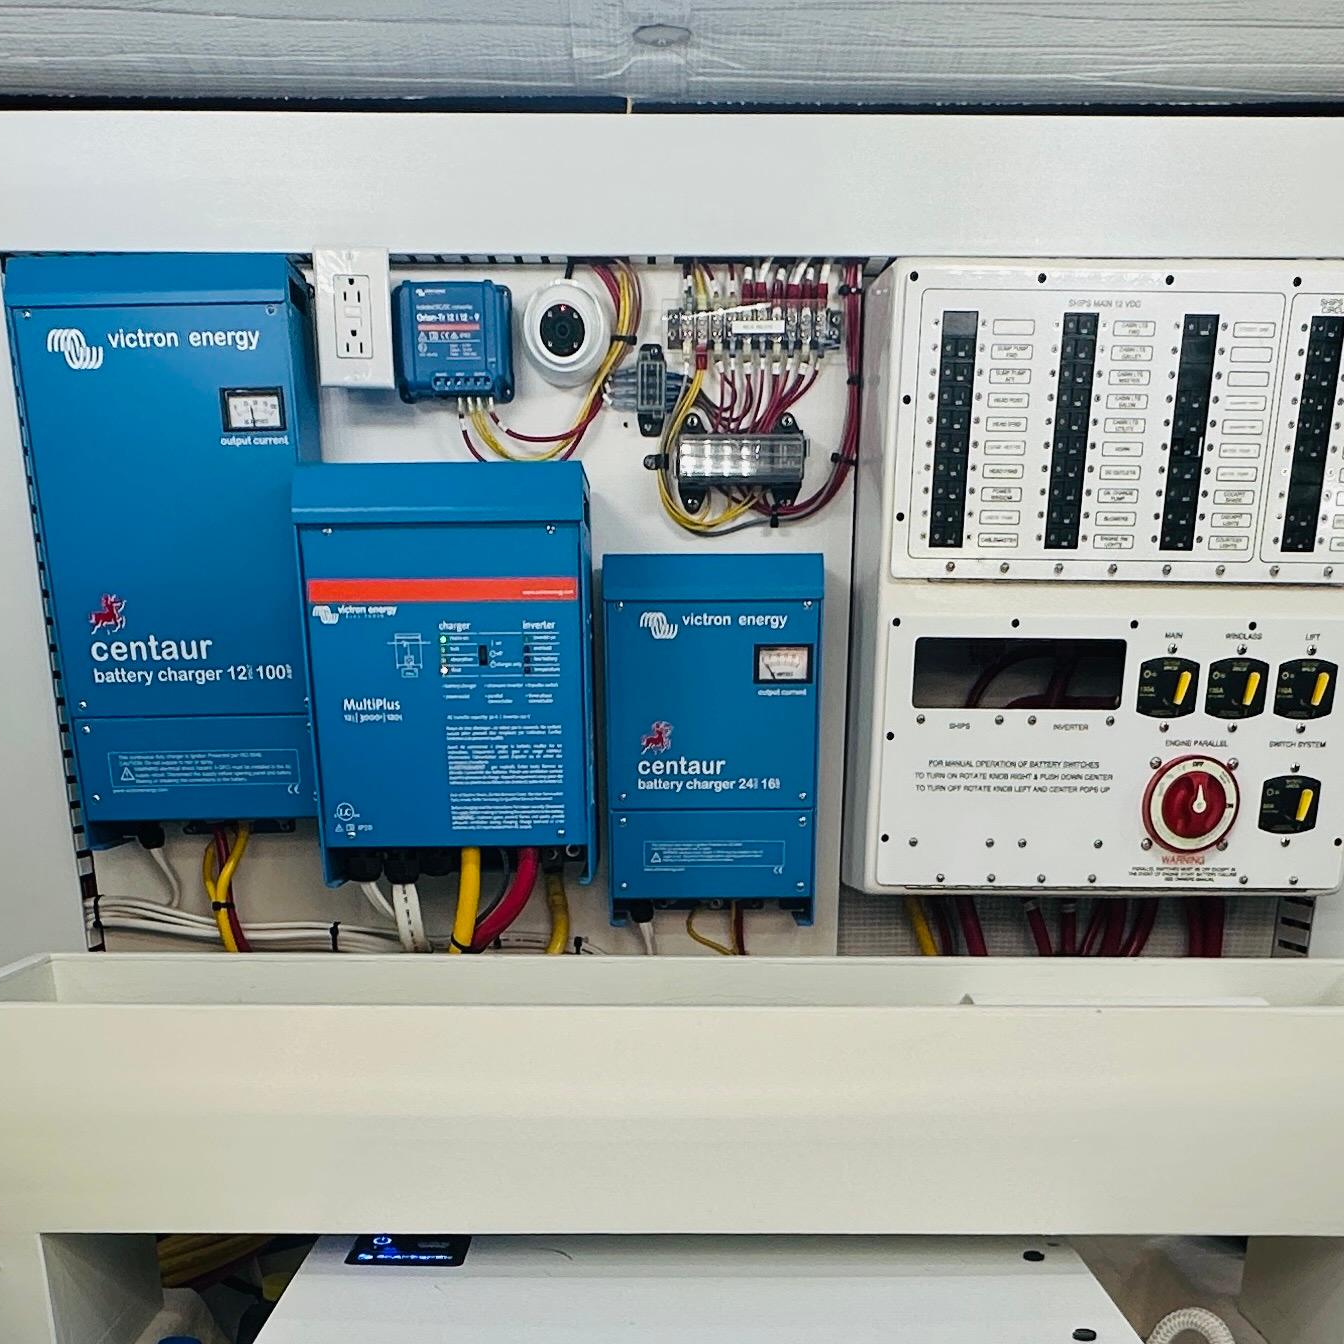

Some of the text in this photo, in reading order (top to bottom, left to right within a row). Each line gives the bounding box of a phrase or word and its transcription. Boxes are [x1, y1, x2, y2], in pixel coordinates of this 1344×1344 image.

[1093, 299, 1113, 308] MAIN
[1115, 300, 1123, 308] 12
[1125, 300, 1142, 308] VDC
[108, 329, 260, 350] victron energy
[220, 434, 289, 447] output current
[338, 604, 367, 615] victron
[367, 605, 398, 616] energy
[438, 620, 556, 632] charger inverter
[681, 612, 788, 629] victron energy
[1305, 633, 1321, 641] LIFT
[91, 634, 213, 662] centaur
[94, 667, 154, 686] battery
[158, 667, 224, 685] charger
[343, 698, 401, 712] MultiPlus
[949, 722, 1089, 731] SHIPS INVERTER
[1193, 740, 1229, 748] PARALLEL
[638, 755, 727, 776] centaur
[928, 759, 1100, 769] FOR MANUAL OPERATION OF BATTERY SWITCHES
[915, 772, 925, 780] TO
[927, 772, 945, 780] TURN
[947, 772, 958, 780] ON
[959, 772, 987, 780] ROTATE
[989, 773, 1009, 781] KNOB
[1010, 773, 1032, 781] RIGHT
[1040, 773, 1059, 781] PUSH
[1061, 773, 1083, 781] DOWN
[1084, 773, 1113, 781] CENTER
[637, 778, 683, 792] battery
[685, 778, 735, 792] charger
[1161, 856, 1206, 865] WARNING
